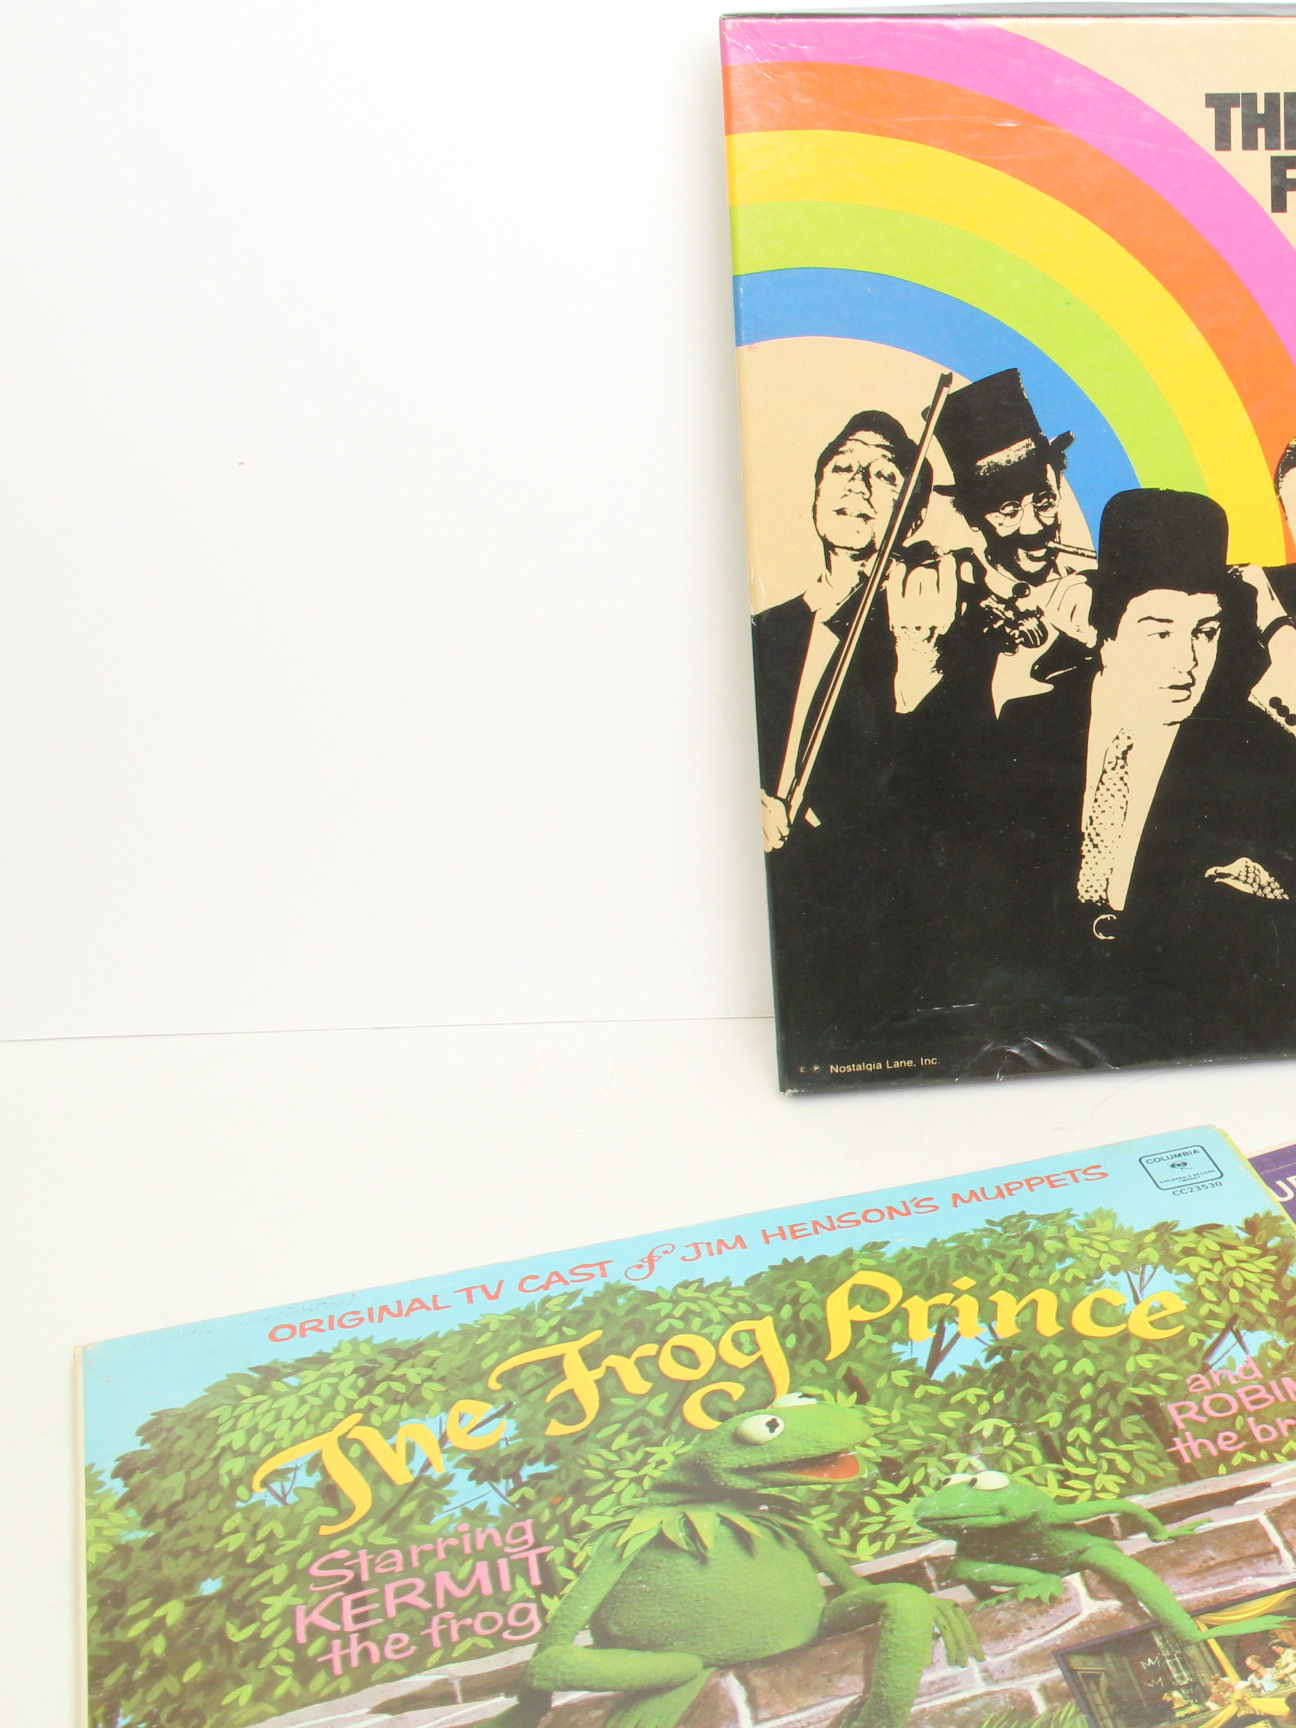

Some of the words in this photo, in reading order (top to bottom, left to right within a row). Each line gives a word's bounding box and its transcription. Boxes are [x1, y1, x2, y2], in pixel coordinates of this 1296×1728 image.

[830, 1061, 883, 1074] Nostalgia
[1145, 1149, 1200, 1165] COLUMBIA
[1172, 1181, 1223, 1196] CC23530
[267, 1294, 452, 1343] ORIGINAL
[454, 1280, 505, 1305] TV
[517, 1259, 614, 1294] CAST
[680, 1234, 748, 1264] JIM
[760, 1196, 941, 1246] HENSON'S
[950, 1164, 1110, 1209] MUPPETS
[252, 1398, 507, 1535] The
[487, 1315, 791, 1436] Frog
[825, 1270, 1187, 1361] Prince
[1186, 1355, 1264, 1394] and
[1166, 1431, 1247, 1464] the
[308, 1518, 535, 1592] Starring
[294, 1546, 554, 1644] KERMIT
[316, 1632, 418, 1676] the
[420, 1602, 542, 1649] frog
